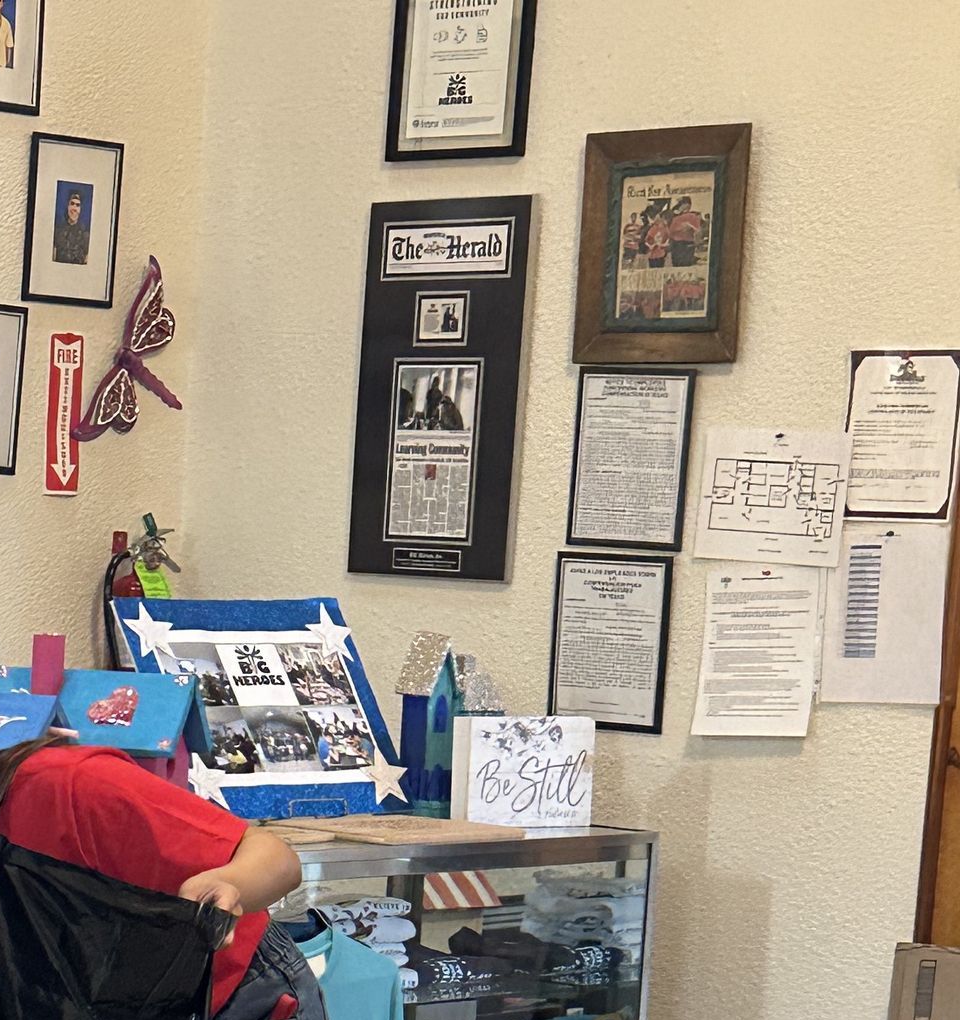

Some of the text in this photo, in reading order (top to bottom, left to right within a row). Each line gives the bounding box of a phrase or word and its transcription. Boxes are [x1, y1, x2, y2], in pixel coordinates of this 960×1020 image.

[392, 233, 502, 261] The Herald
[57, 348, 78, 364] FIRE
[396, 443, 428, 456] Learning
[232, 674, 286, 687] HEROES
[476, 749, 587, 815] Be Still
